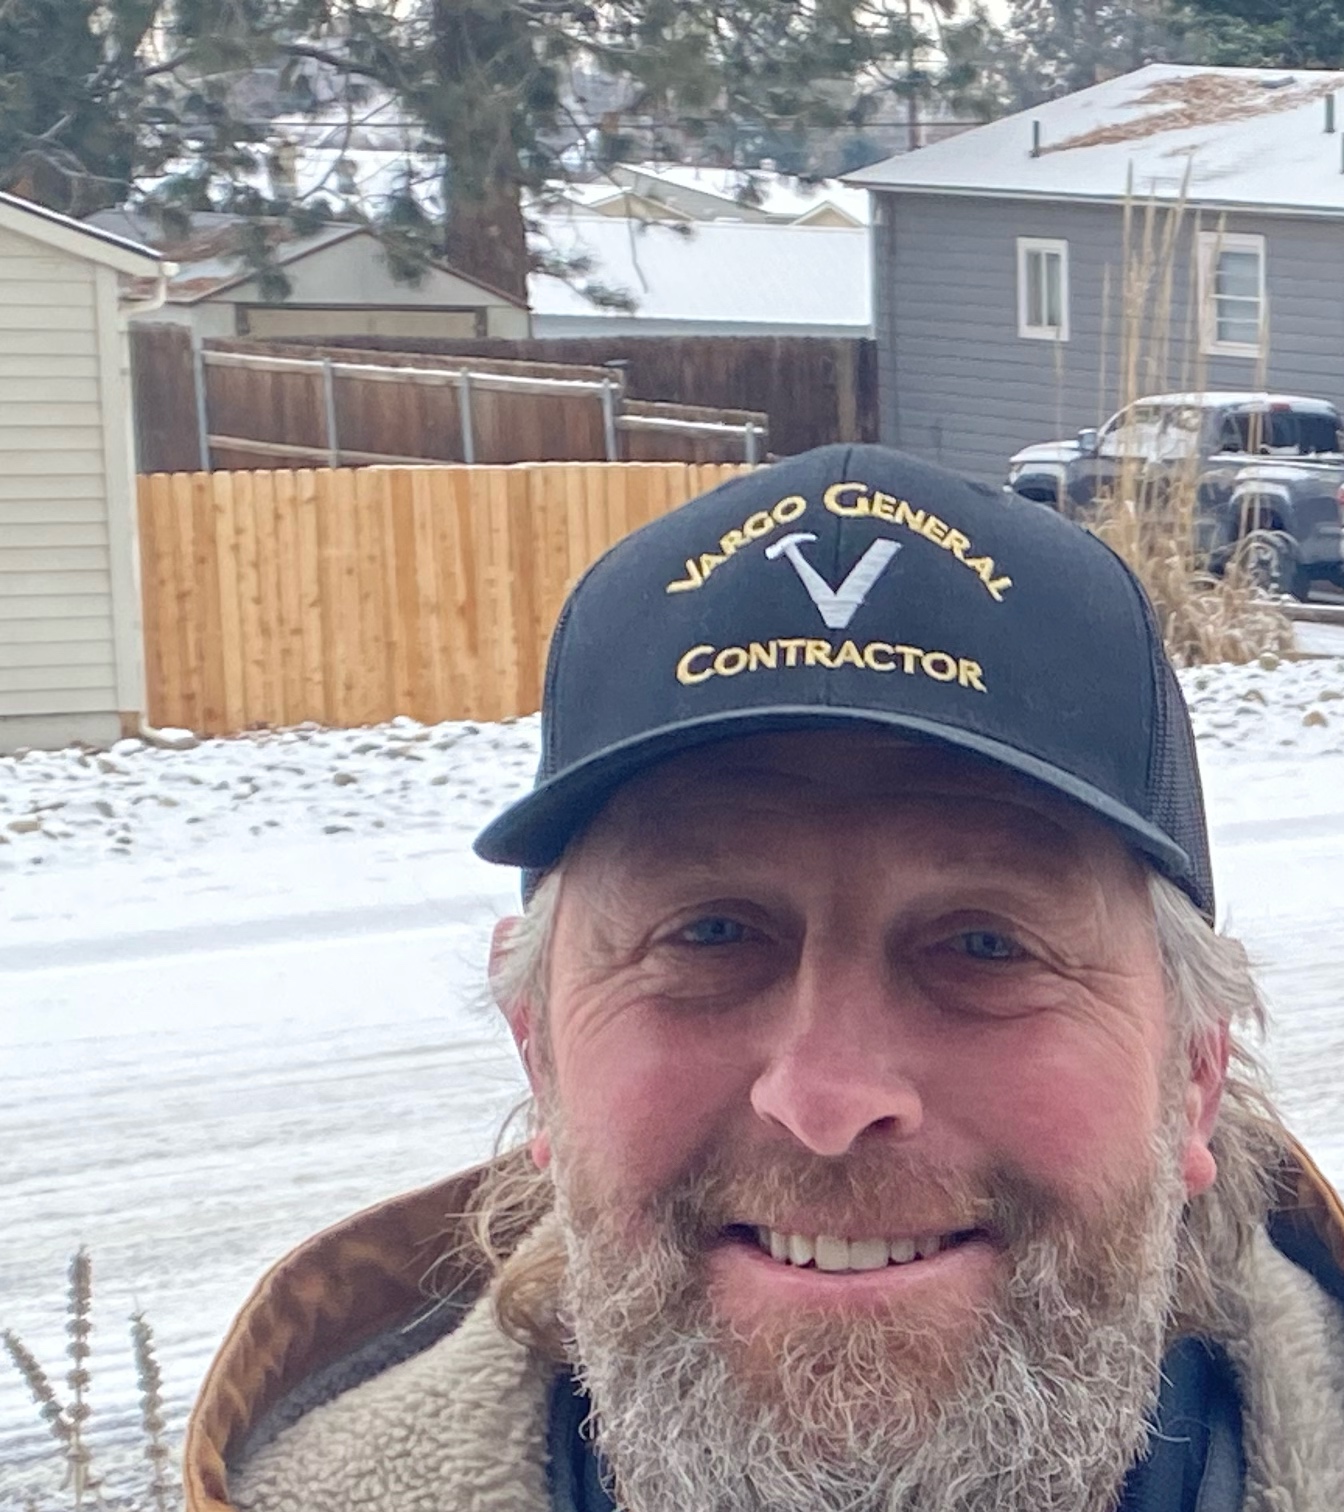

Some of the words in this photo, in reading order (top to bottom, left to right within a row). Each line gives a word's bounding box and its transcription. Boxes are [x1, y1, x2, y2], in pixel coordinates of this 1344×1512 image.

[666, 495, 807, 593] VARGO
[823, 482, 1013, 602] GENERAL
[676, 637, 987, 692] CONTRACTOR
